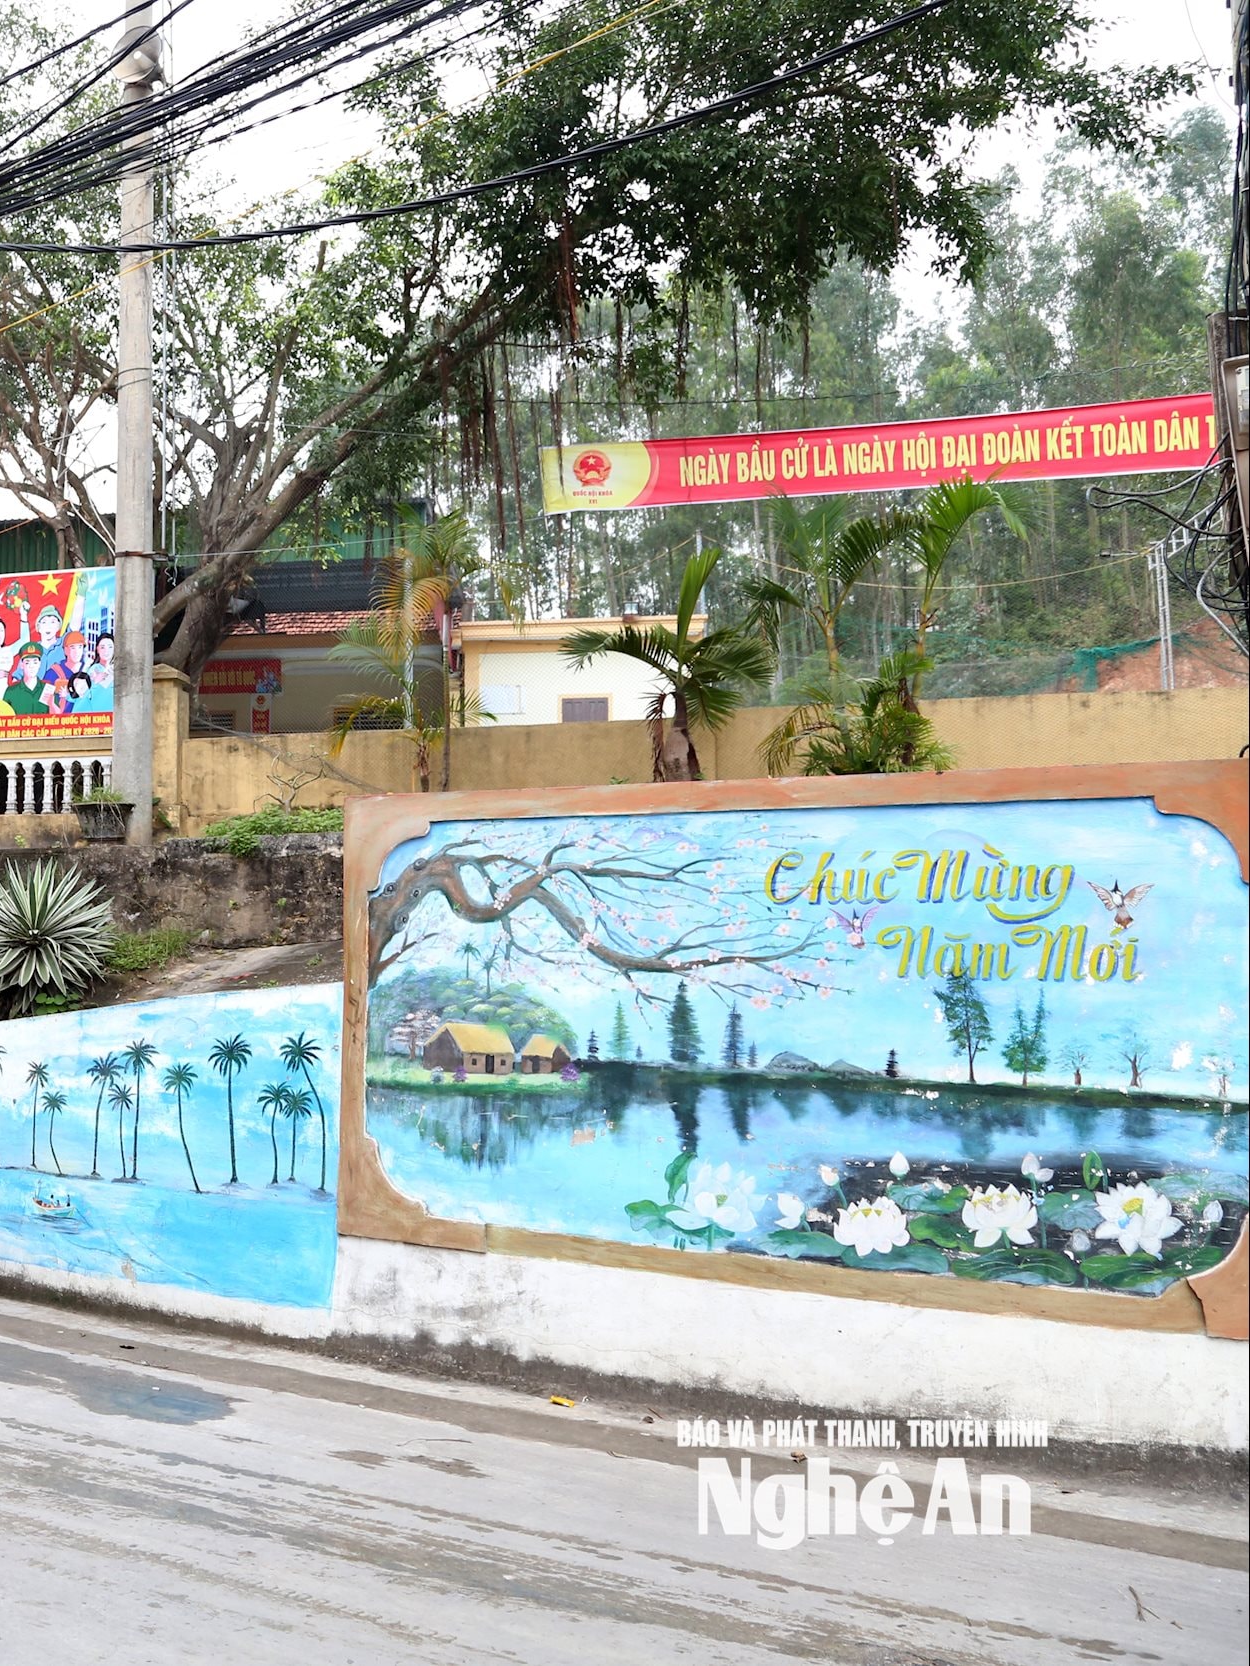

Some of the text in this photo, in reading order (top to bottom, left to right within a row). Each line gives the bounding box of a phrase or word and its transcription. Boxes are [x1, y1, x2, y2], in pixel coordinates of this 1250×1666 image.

[679, 447, 731, 487] NGÀY
[736, 440, 775, 483] BẦU
[781, 437, 810, 479] CỬ
[813, 439, 839, 477] LÀ
[842, 434, 896, 474] NGÀY
[902, 431, 936, 477] HỘI
[942, 434, 977, 474] ĐẠI
[982, 424, 1040, 465] ĐOÀN
[1046, 415, 1085, 461] KẾT
[1089, 415, 1148, 457] TOÀN
[1153, 410, 1200, 452] DÂN
[763, 842, 1075, 925] Chúc Mừng
[876, 924, 1144, 983] Năm Mới
